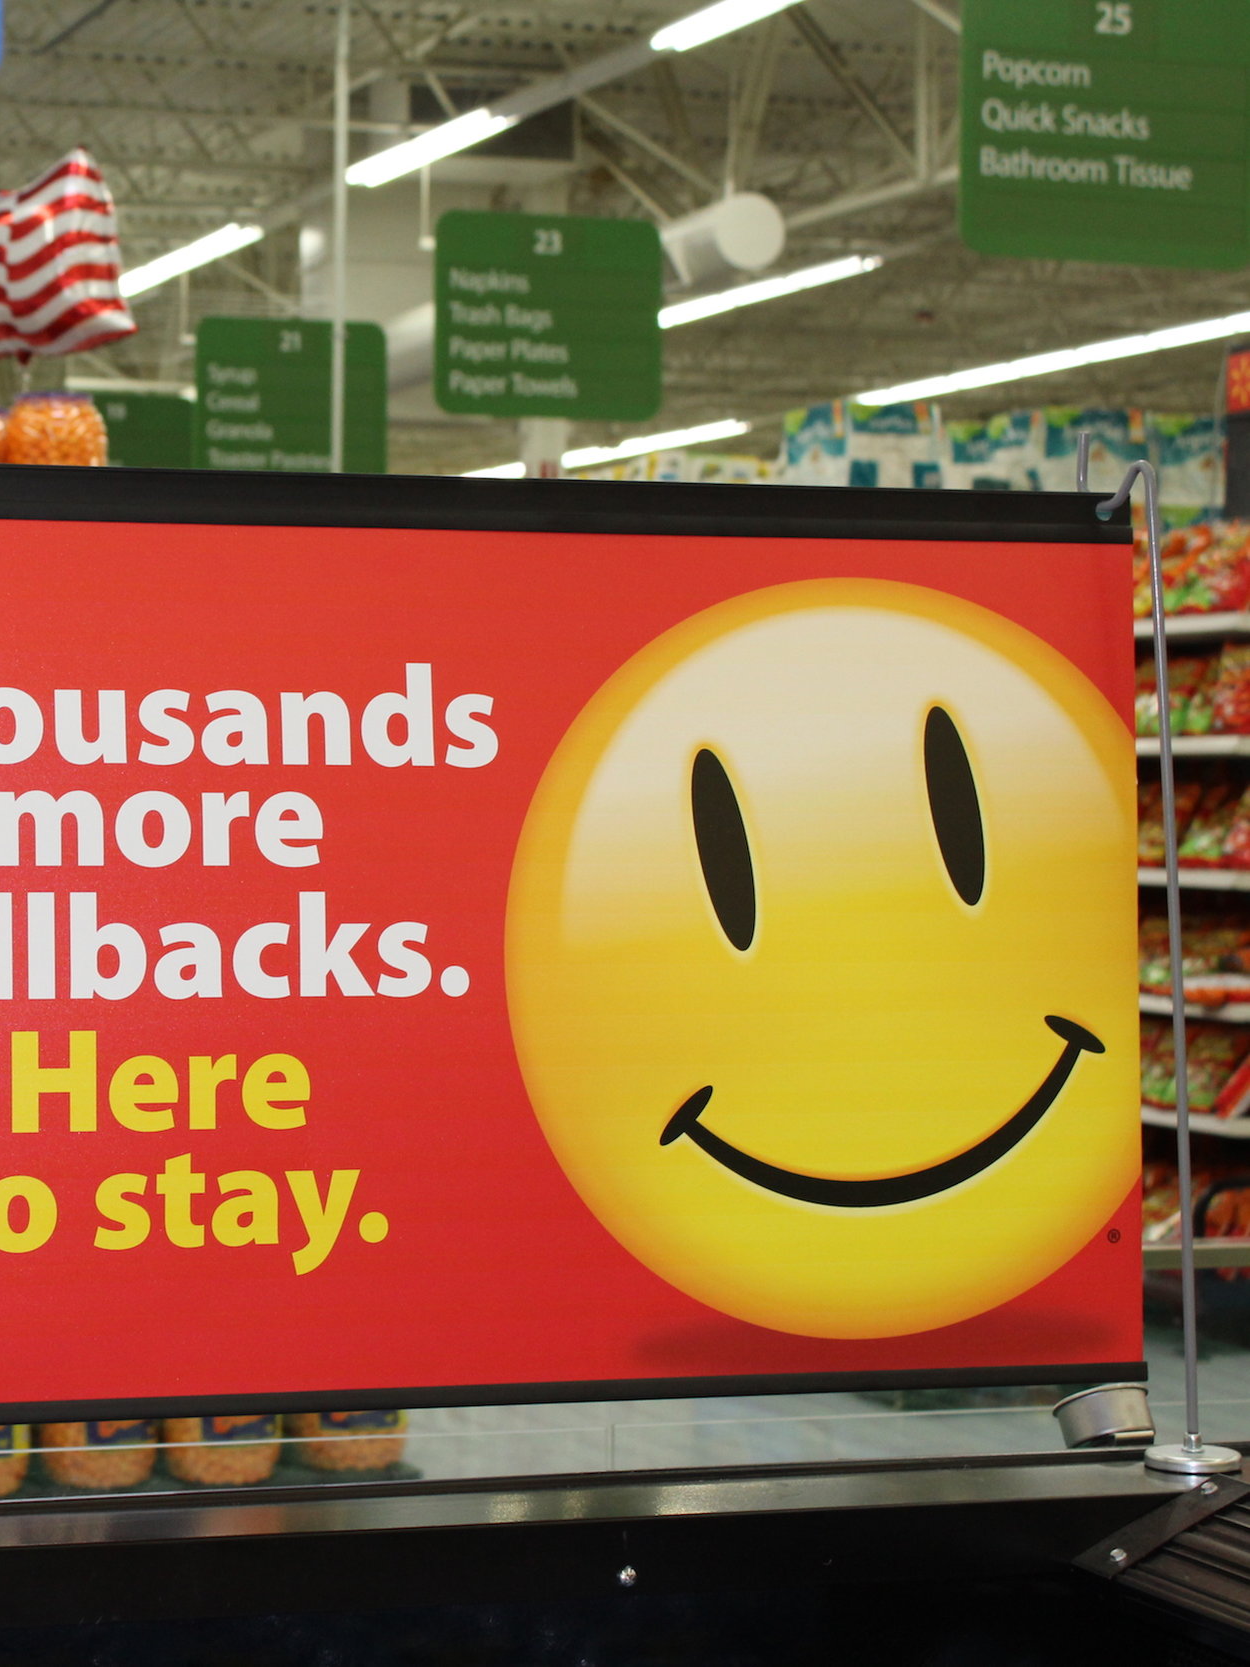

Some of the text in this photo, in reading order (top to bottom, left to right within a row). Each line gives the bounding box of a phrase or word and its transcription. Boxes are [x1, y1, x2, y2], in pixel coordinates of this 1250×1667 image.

[1095, 2, 1133, 35] 25
[982, 50, 1092, 89] Popcorn
[981, 97, 1151, 140] Quick Snacks
[979, 145, 1193, 190] Bathroom Tissue
[533, 229, 564, 255] 23
[449, 267, 531, 295] Napkins
[449, 336, 569, 364] Paper Plates
[449, 370, 578, 399] Paper Towels
[11, 1030, 311, 1133] Here
[94, 1152, 389, 1276] stay.
